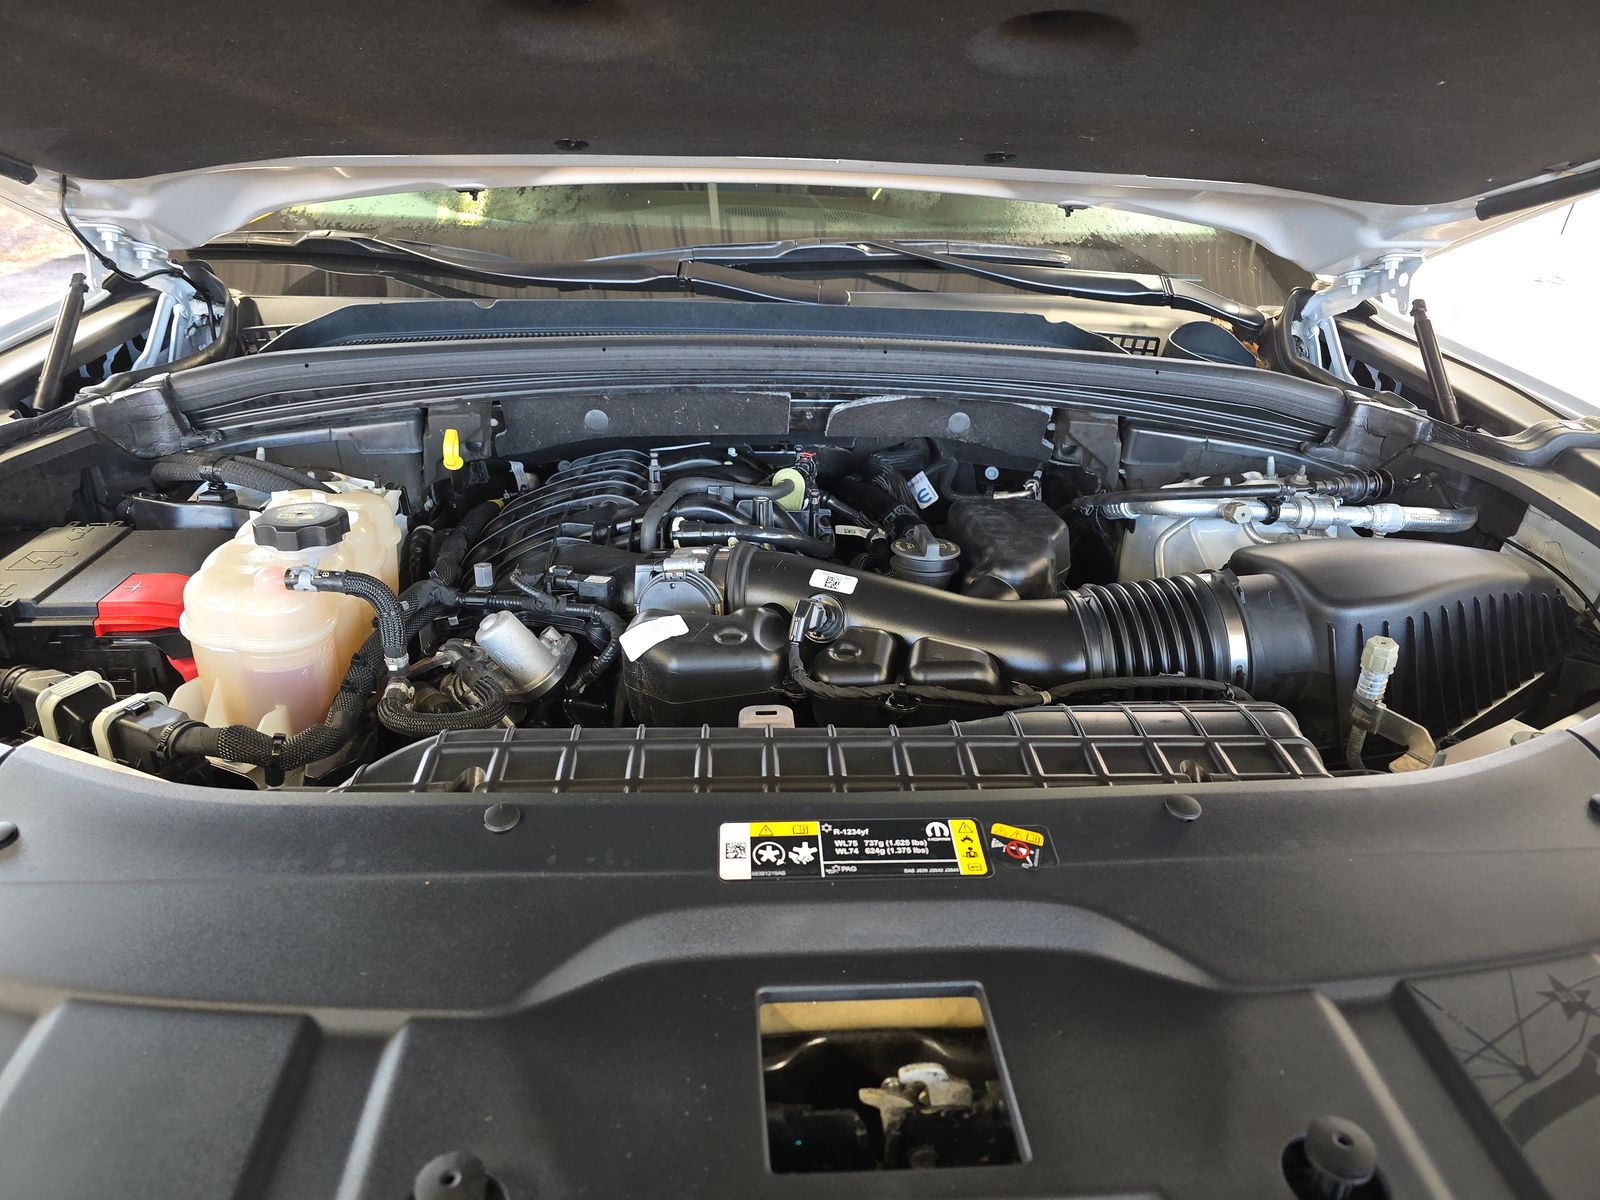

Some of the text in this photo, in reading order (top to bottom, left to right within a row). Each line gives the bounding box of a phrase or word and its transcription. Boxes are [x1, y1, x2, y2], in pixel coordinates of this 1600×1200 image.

[833, 828, 869, 836] R-1234yf
[864, 840, 885, 848] 737g
[911, 839, 928, 847] lbs)
[865, 847, 885, 856] 624g
[913, 847, 929, 855] lbs)
